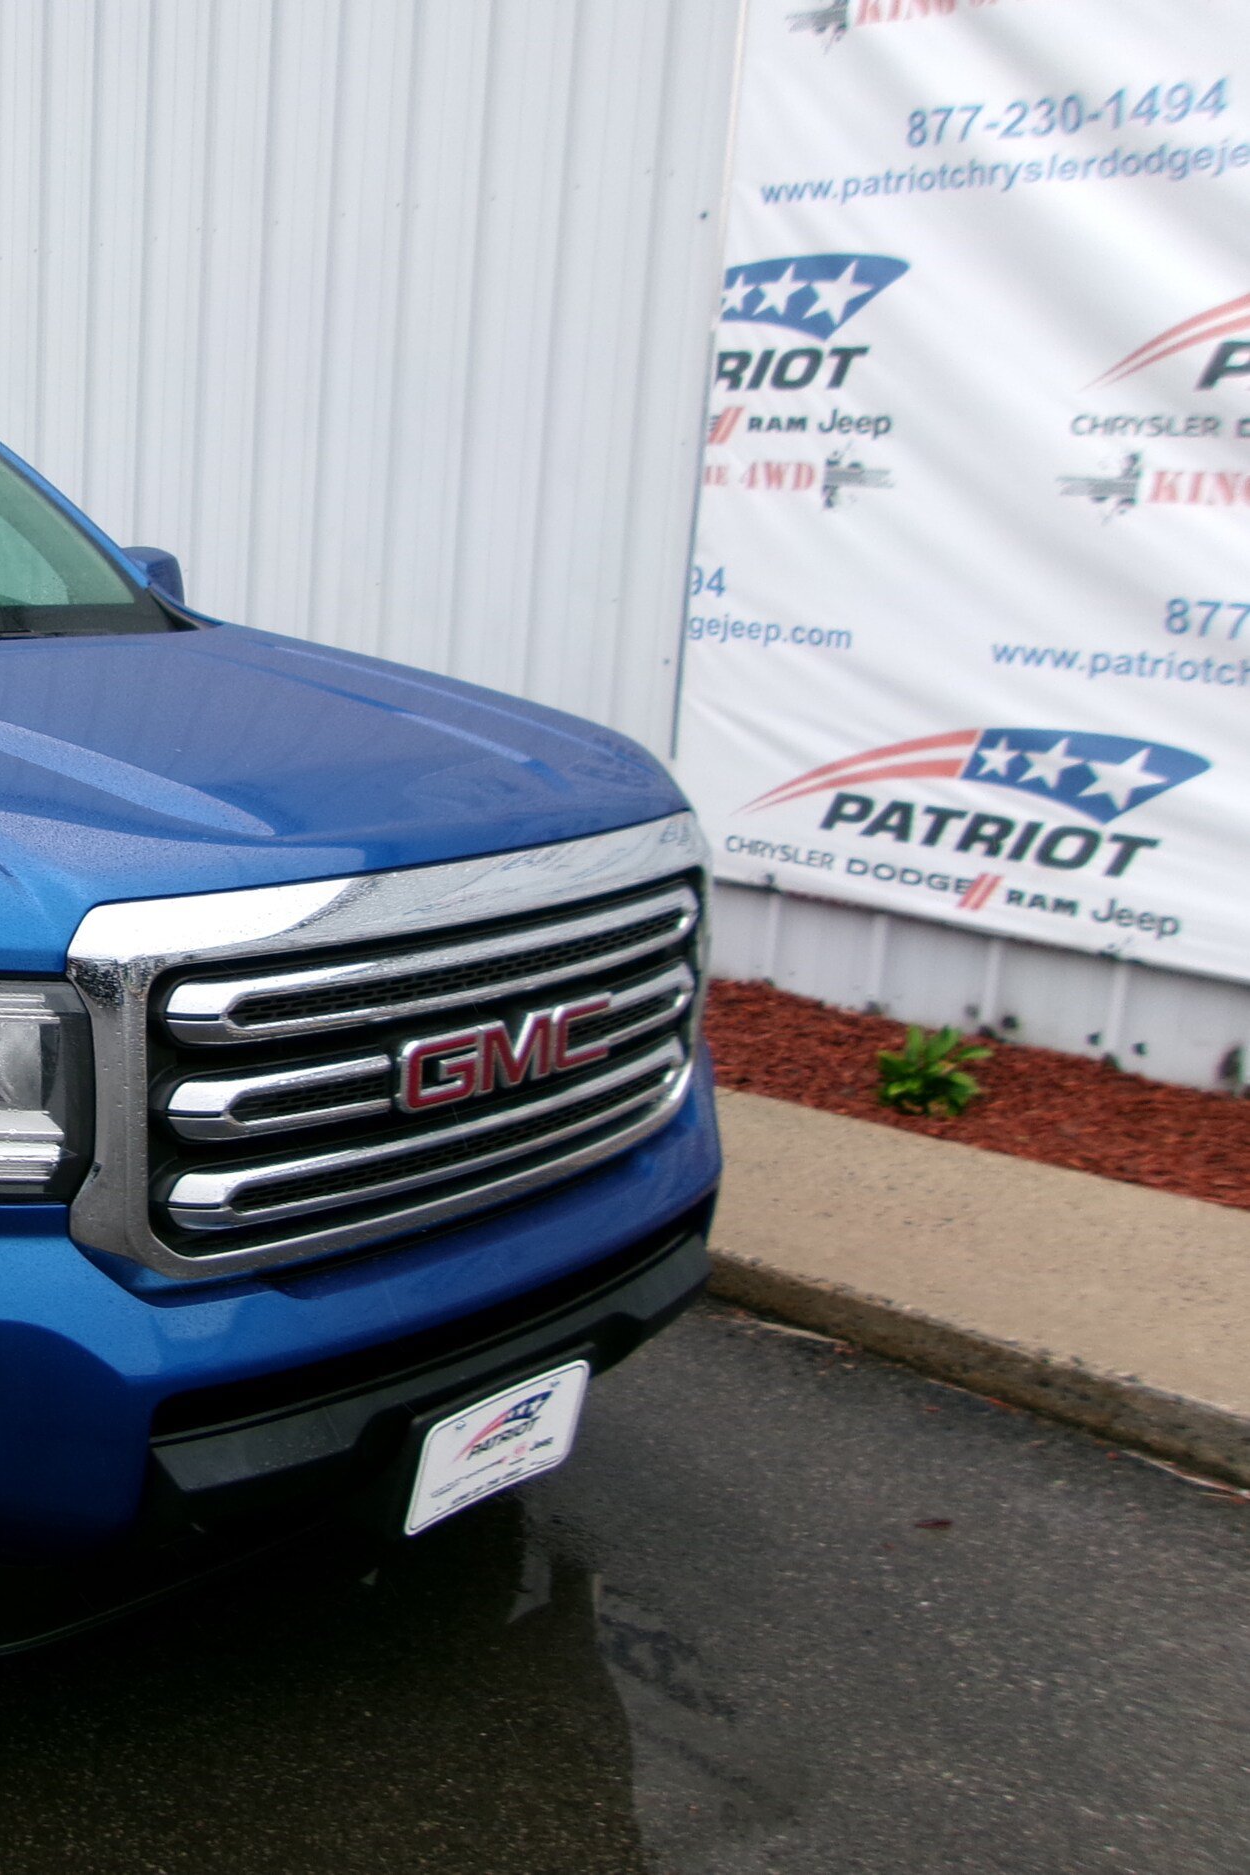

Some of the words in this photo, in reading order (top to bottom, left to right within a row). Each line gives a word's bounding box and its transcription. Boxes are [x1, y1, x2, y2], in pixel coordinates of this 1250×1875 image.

[906, 76, 1229, 149] 877-230-1494
[748, 416, 807, 433] RAM
[818, 408, 892, 438] Jeep
[1071, 413, 1222, 437] CHRYSLER
[743, 461, 816, 490] 4WD
[688, 613, 852, 649] gejeep.com
[820, 791, 1160, 878] PATRIOT
[726, 833, 835, 872] CHRYSLER
[846, 857, 974, 896] DODGE
[1007, 888, 1078, 917] RAM
[1092, 896, 1181, 938] Jeep
[398, 992, 612, 1113] GMC
